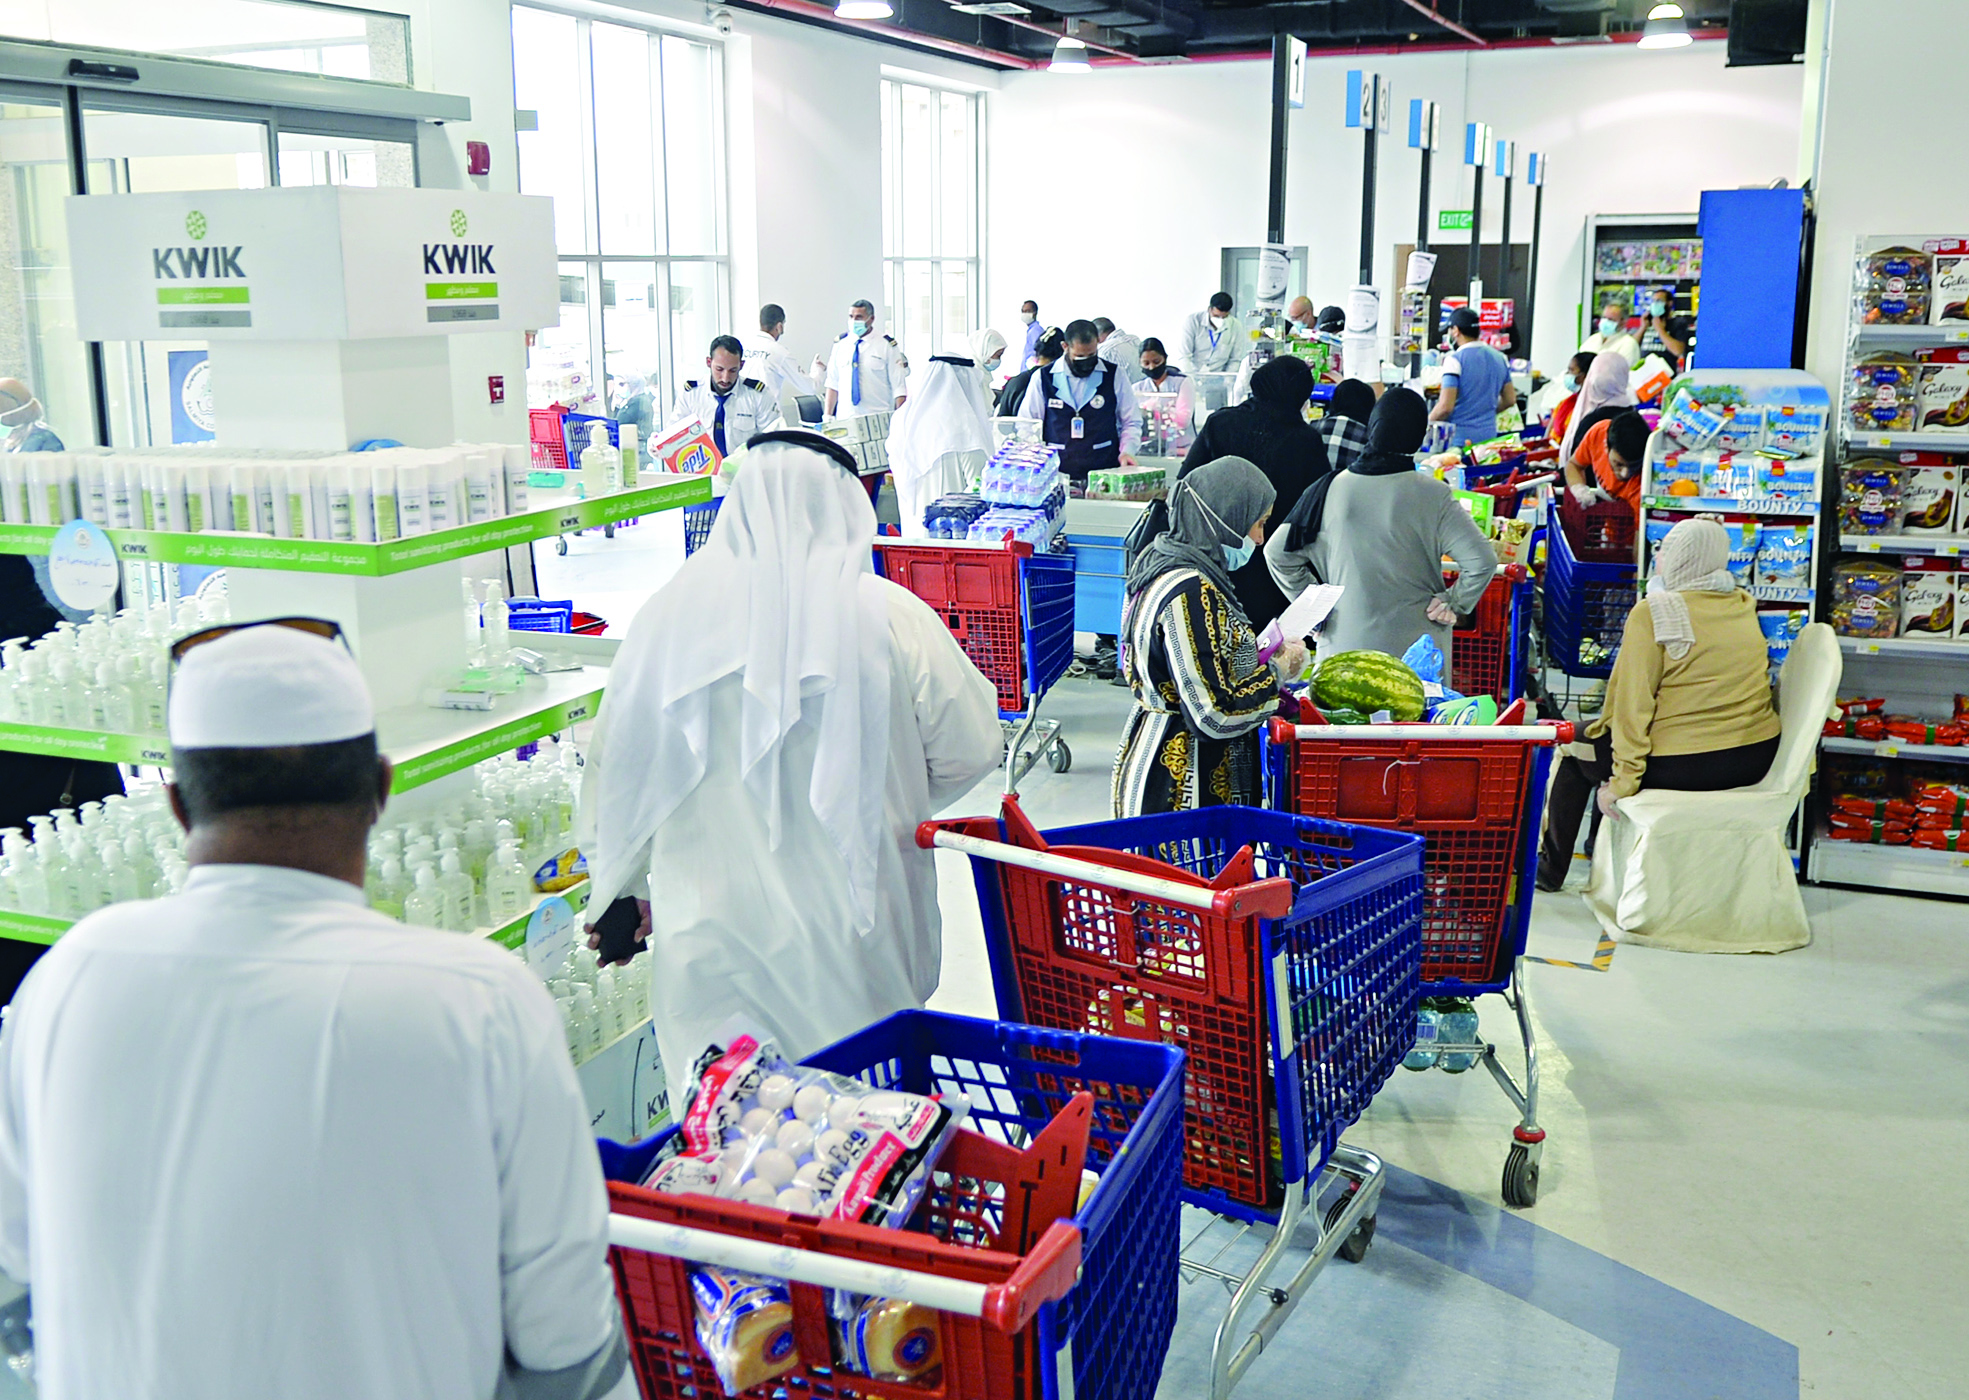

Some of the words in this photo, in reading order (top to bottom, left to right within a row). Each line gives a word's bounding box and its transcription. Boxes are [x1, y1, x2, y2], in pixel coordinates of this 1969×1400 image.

[1294, 53, 1300, 93] 1
[1363, 84, 1370, 117] 2
[1380, 89, 1387, 122] 3
[1441, 213, 1459, 226] EXIT
[152, 246, 247, 279] KWIK
[423, 244, 496, 274] KWIK
[1940, 275, 1969, 290] Gala
[1922, 382, 1962, 397] Galaxy
[1775, 422, 1818, 433] BOUNTY
[682, 444, 711, 473] Tide
[1767, 482, 1812, 492] BOUNTY
[1904, 485, 1939, 500] Galaxy
[1737, 501, 1803, 514] BOUNTY
[561, 517, 579, 528] KWIK
[121, 542, 147, 555] KWIK
[1758, 550, 1808, 563] BOUNTY
[1747, 586, 1798, 601] OUNTY
[1904, 590, 1944, 605] Galaxy
[568, 706, 586, 720] KWIK
[142, 750, 167, 761] KWIK
[647, 1089, 669, 1119] KW
[828, 1129, 870, 1167] Egg
[863, 1140, 898, 1183] Product
